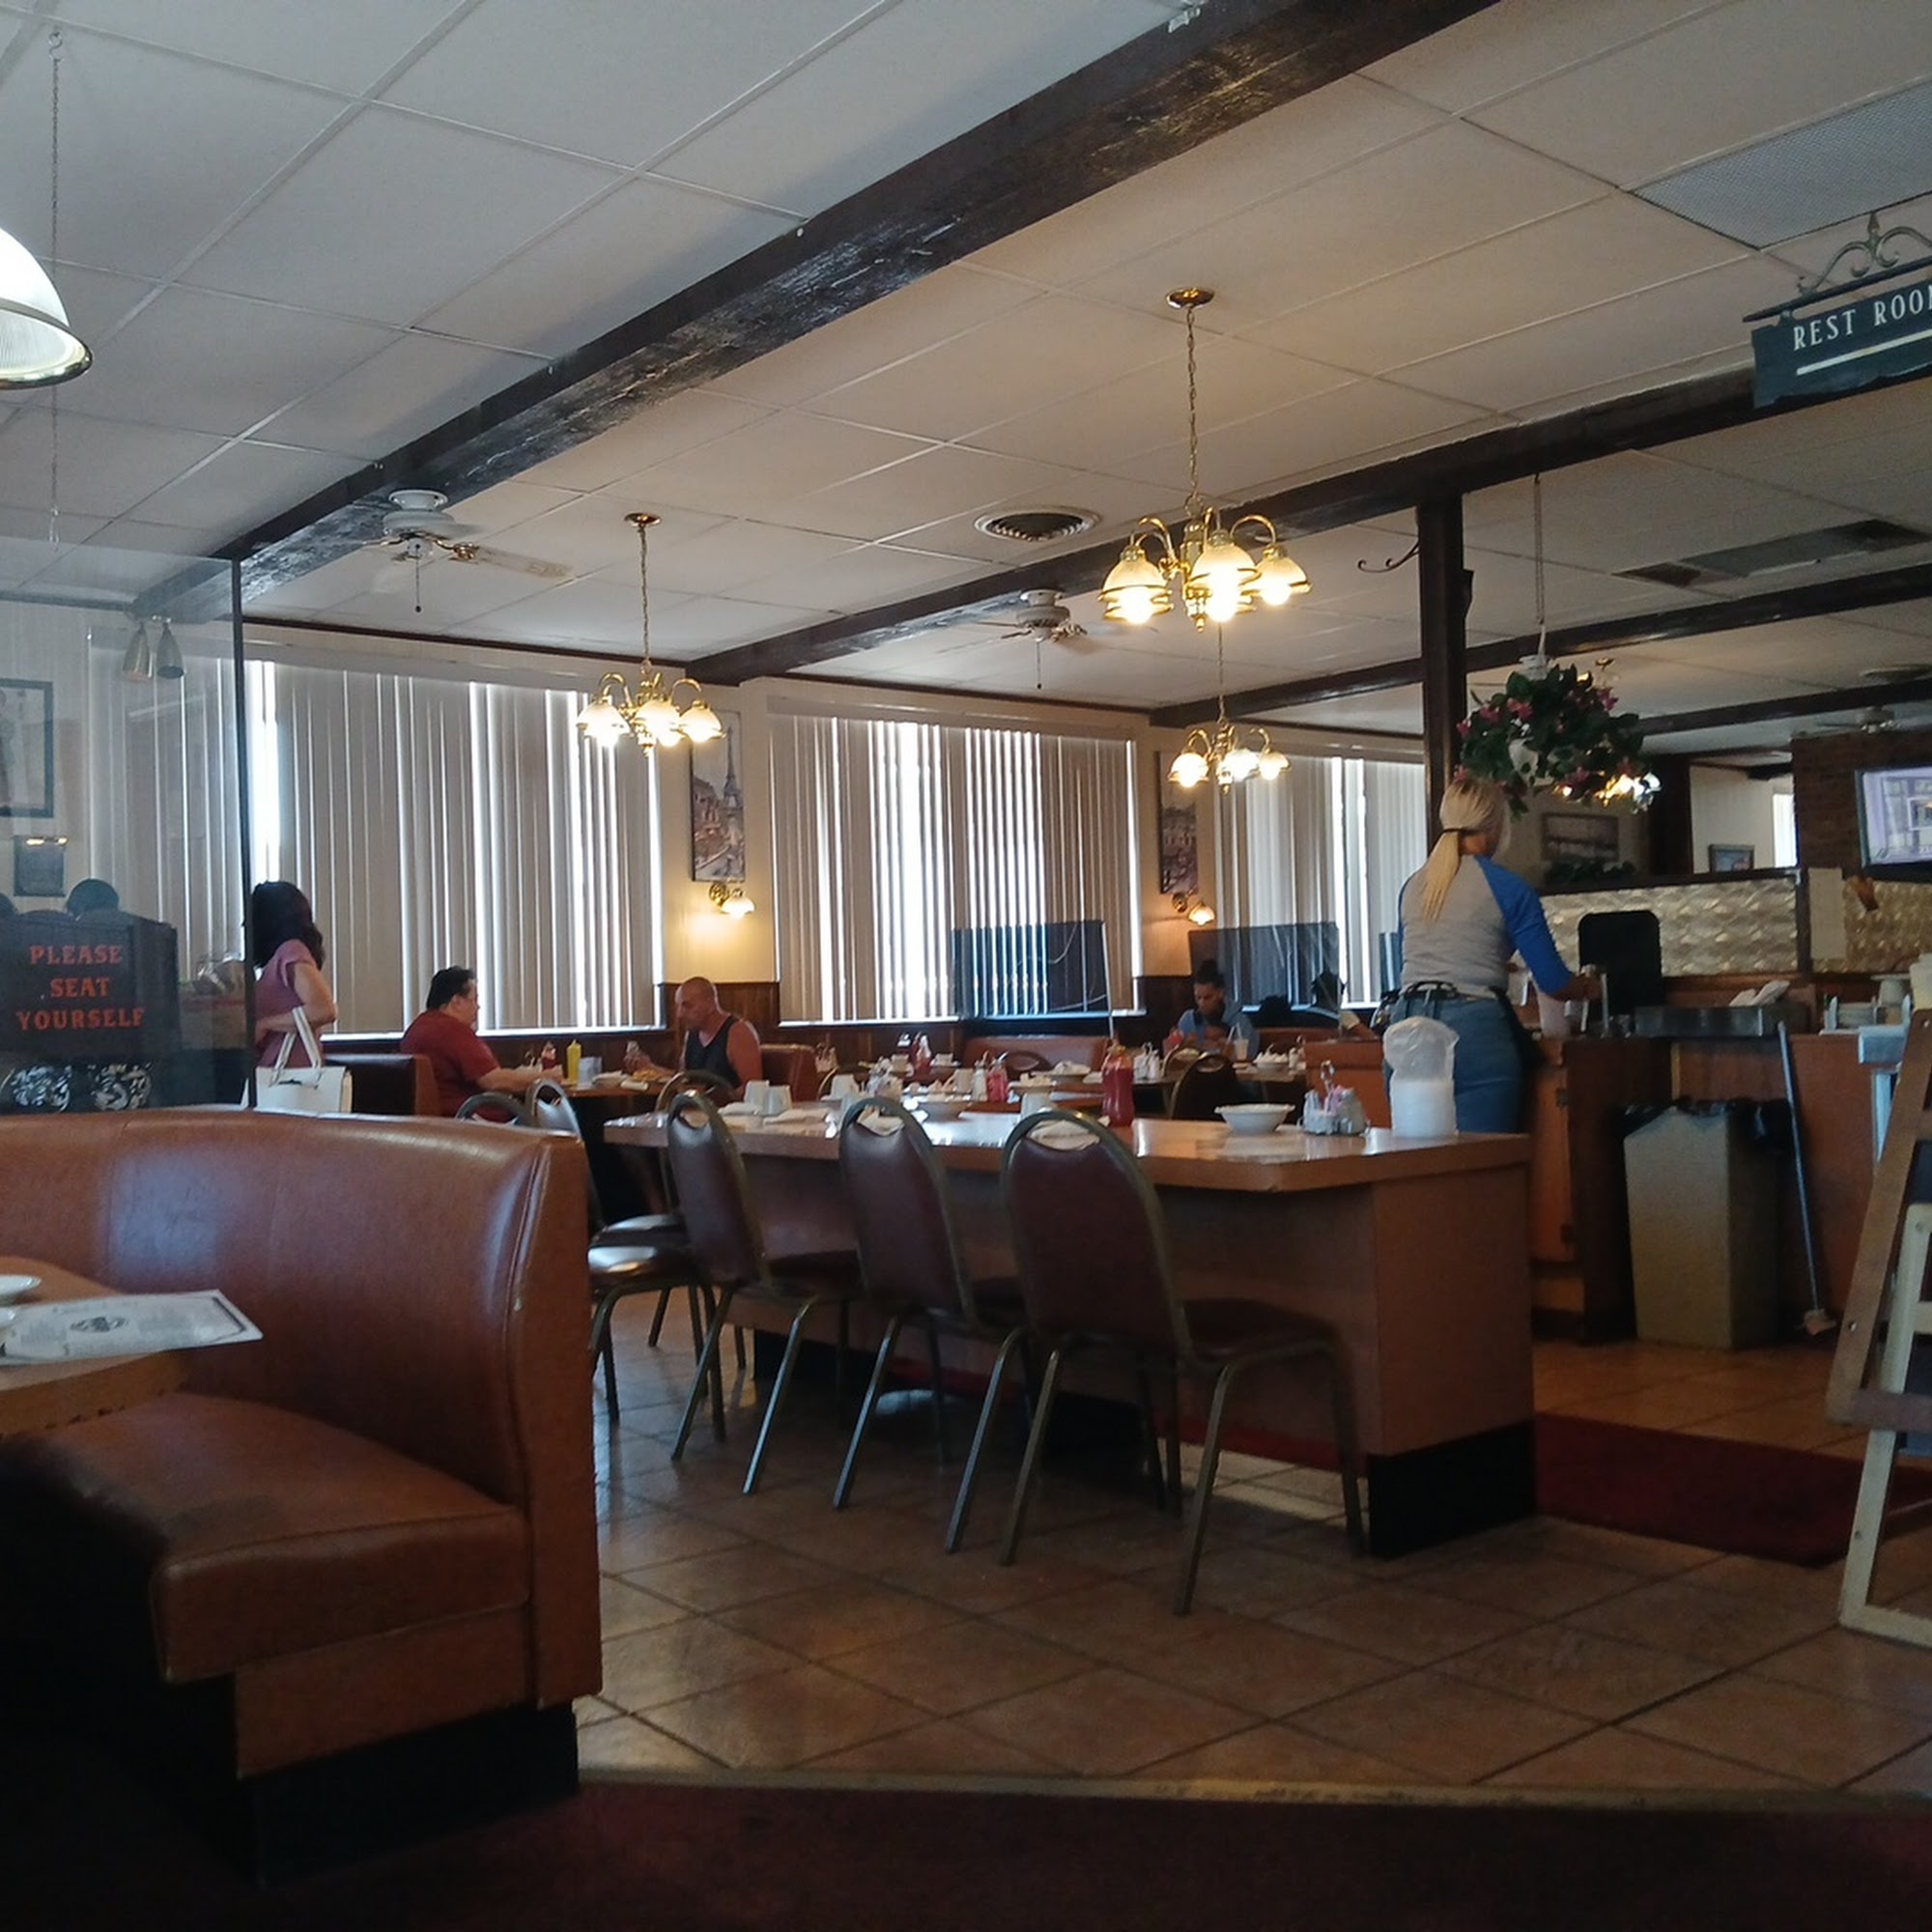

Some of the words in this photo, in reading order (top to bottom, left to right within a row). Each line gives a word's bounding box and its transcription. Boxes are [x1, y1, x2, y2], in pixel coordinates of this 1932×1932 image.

[1793, 309, 1857, 352] REST
[1874, 284, 1932, 327] ROO
[30, 944, 123, 965] PLEASE
[49, 977, 110, 998] SEAT
[15, 1007, 145, 1032] YOURSELF
